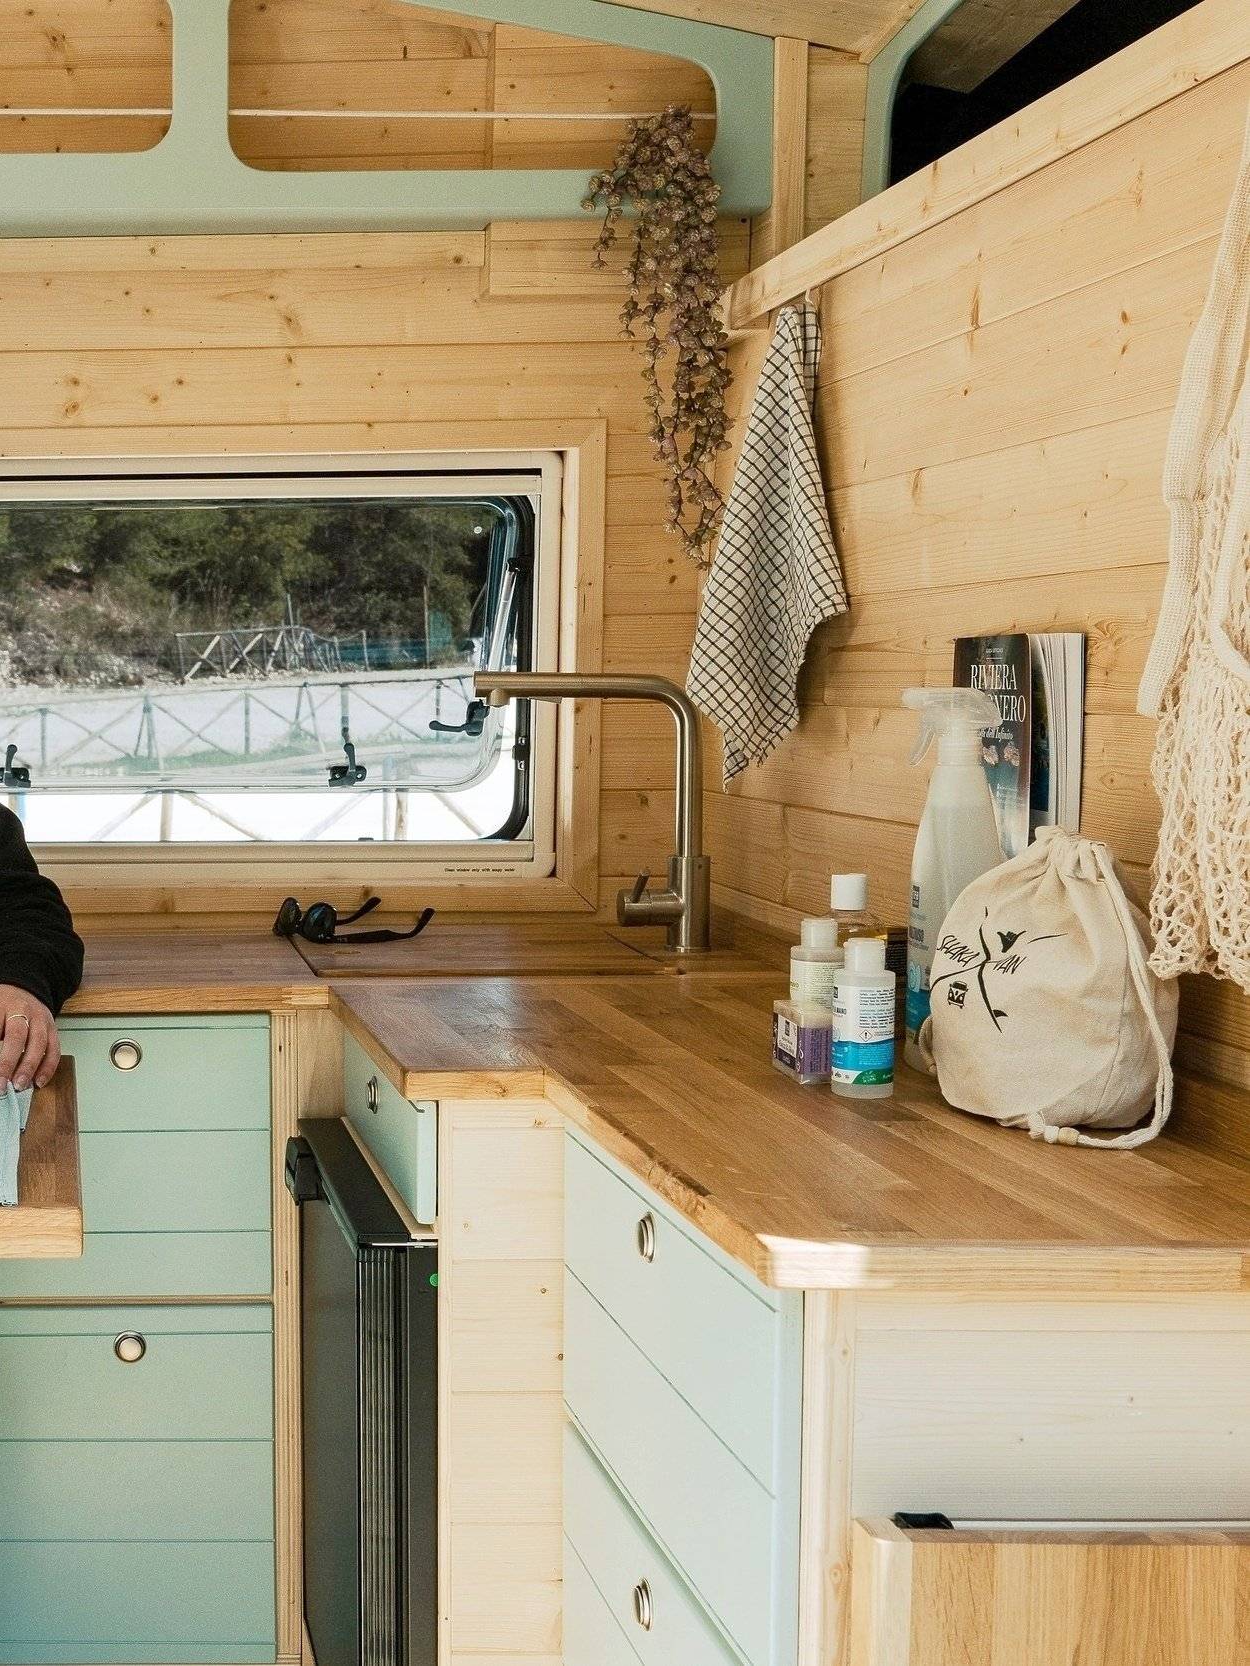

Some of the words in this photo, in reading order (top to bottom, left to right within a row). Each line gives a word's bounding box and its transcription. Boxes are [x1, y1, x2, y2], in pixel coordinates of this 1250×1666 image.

[970, 663, 1018, 690] RIVIERA
[988, 694, 1027, 723] NERO
[936, 934, 981, 968] SHAKA
